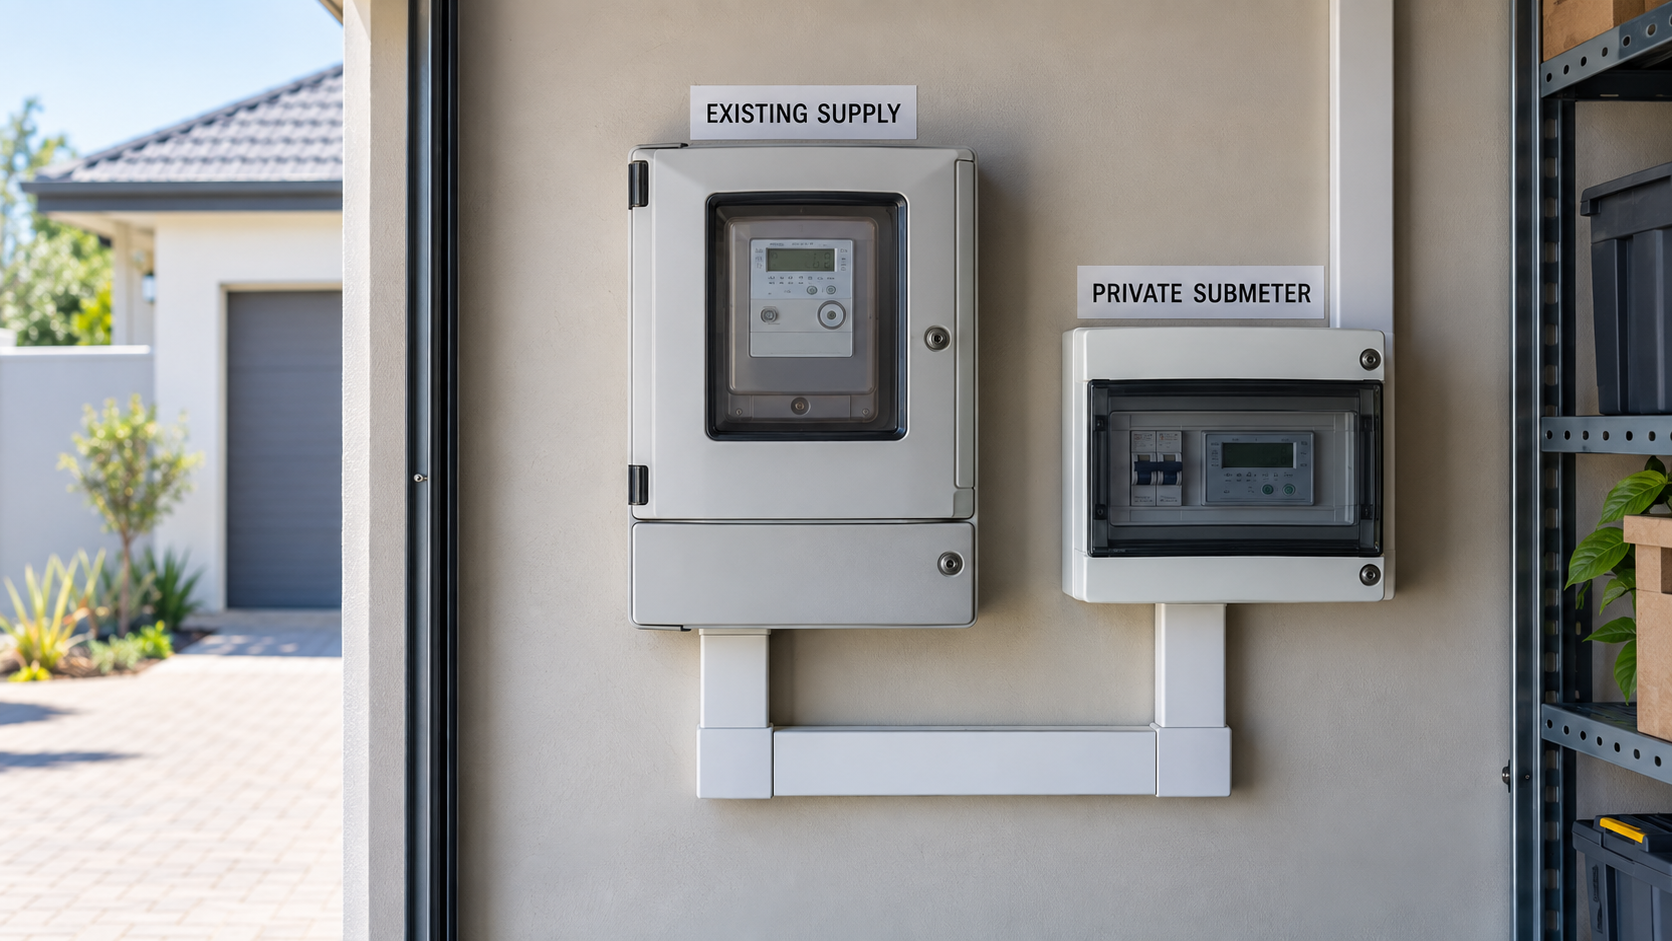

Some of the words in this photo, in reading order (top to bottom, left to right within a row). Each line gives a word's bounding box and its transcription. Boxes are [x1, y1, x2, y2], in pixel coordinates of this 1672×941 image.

[707, 102, 808, 124] EXISTING
[817, 102, 902, 124] SUPPLY
[1092, 282, 1183, 304] PRIVATE
[1193, 282, 1311, 304] SUBMETER
